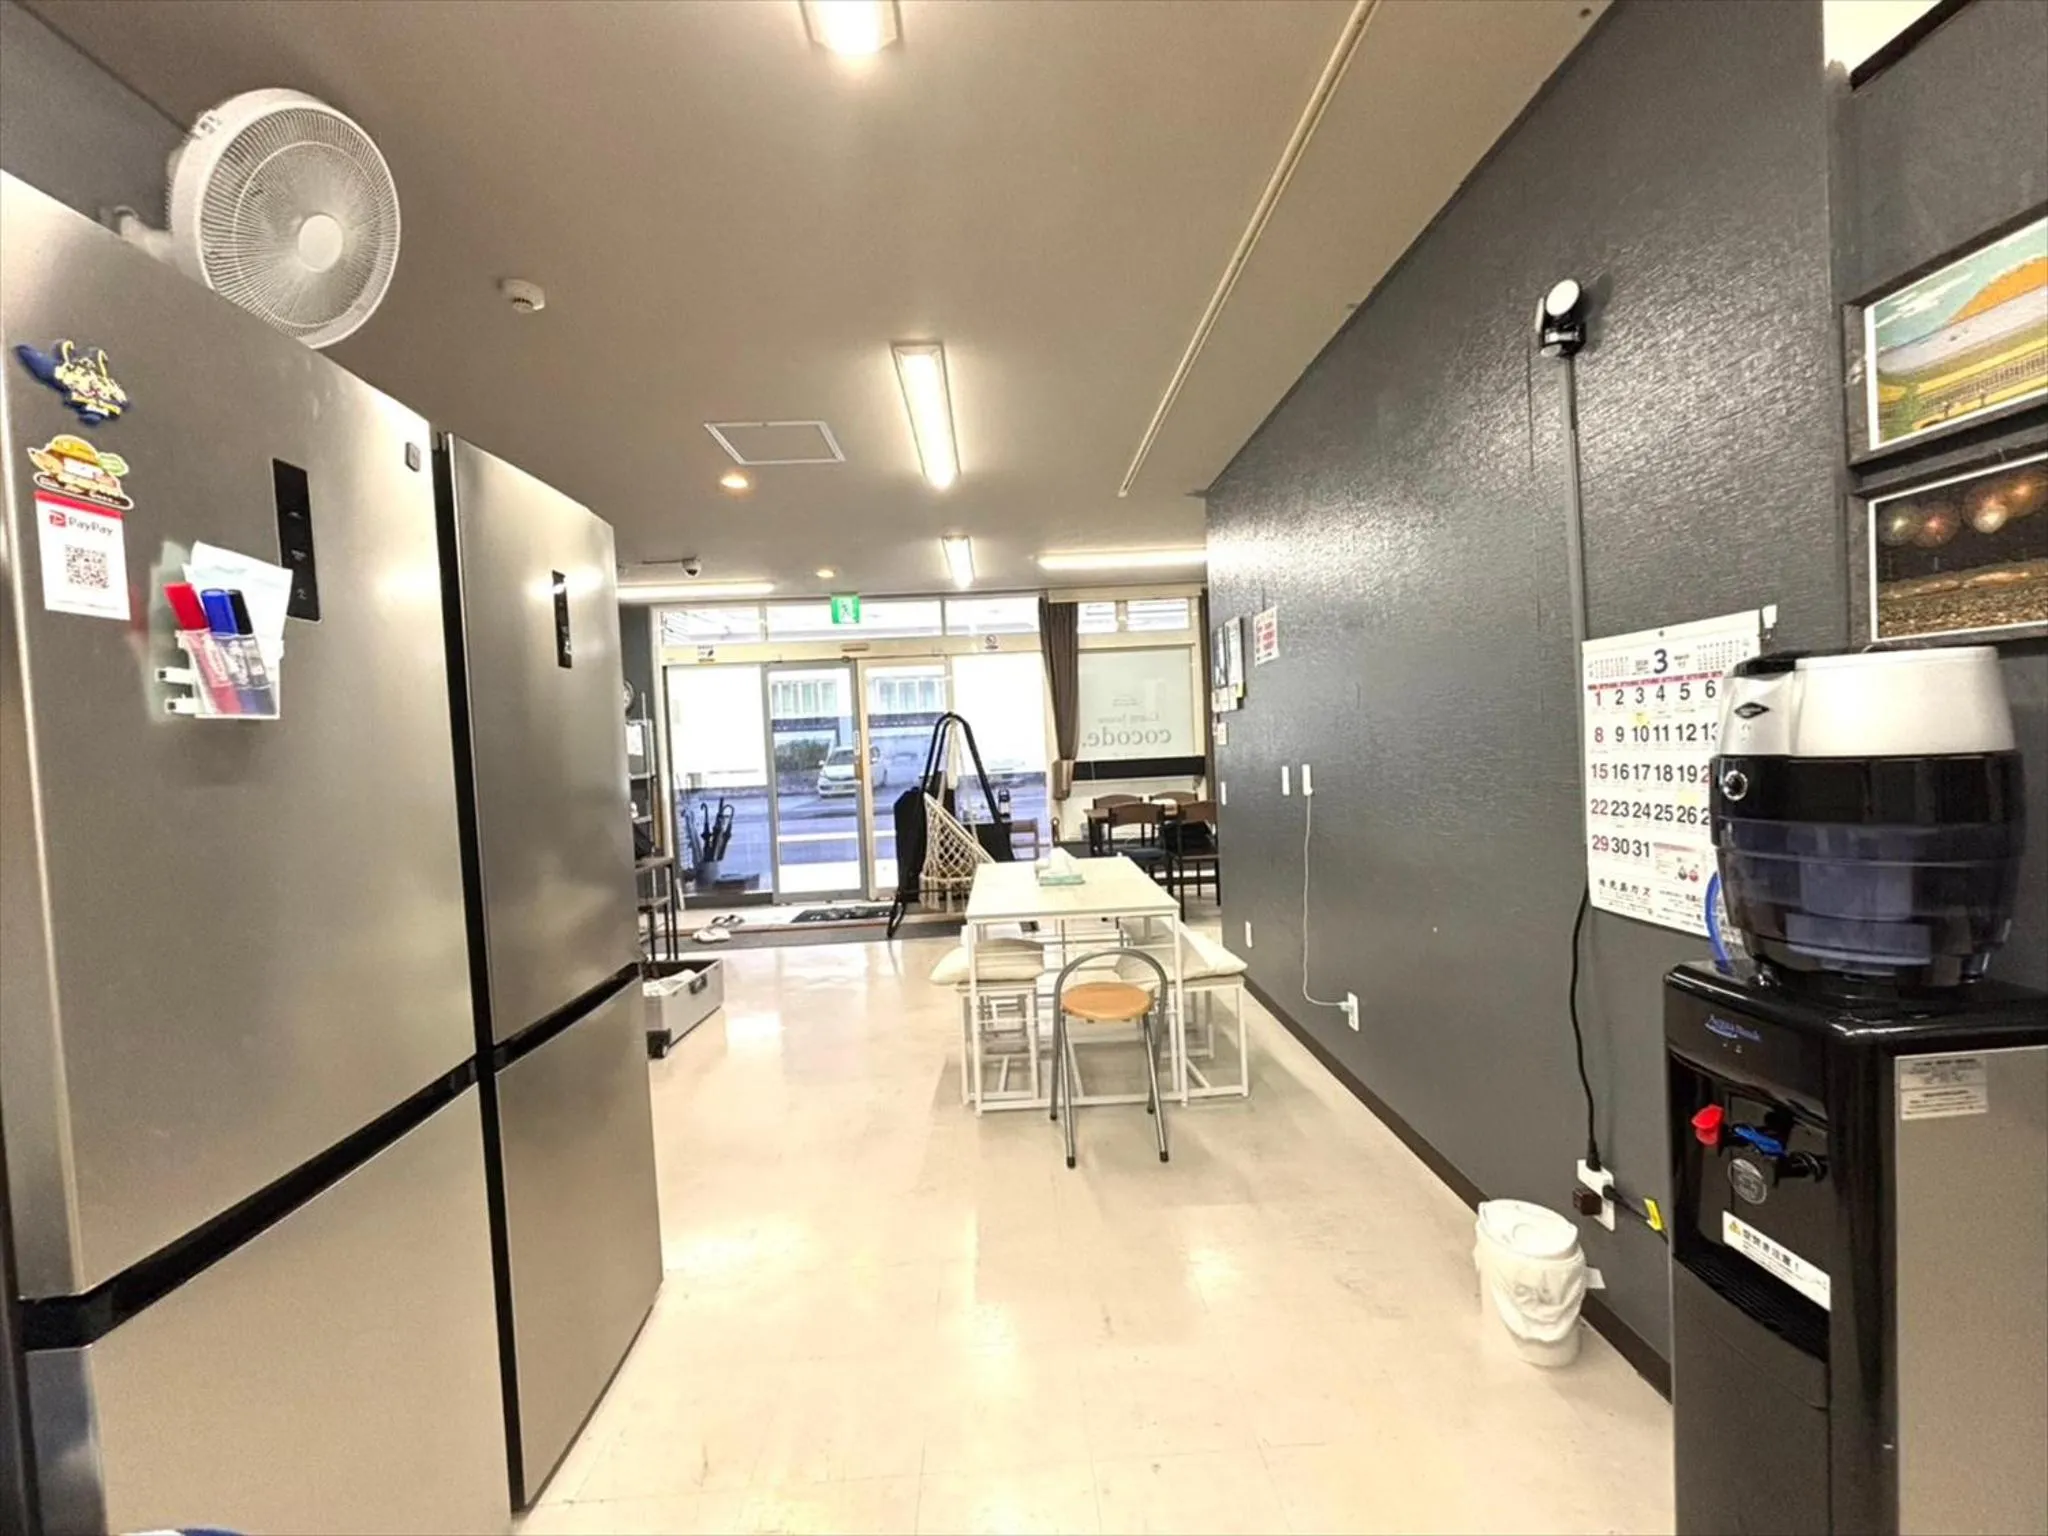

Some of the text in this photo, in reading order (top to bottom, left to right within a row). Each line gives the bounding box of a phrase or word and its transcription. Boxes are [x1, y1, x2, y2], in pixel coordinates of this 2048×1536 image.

[68, 516, 113, 537] PayPay
[1653, 648, 1669, 674] 3
[1594, 691, 1602, 706] 1
[1615, 689, 1625, 705] 2
[1635, 687, 1645, 704] 3
[1656, 685, 1666, 702] 4
[1679, 683, 1691, 701] 5
[1705, 680, 1716, 698] 6
[1594, 727, 1604, 743] 8
[1615, 726, 1625, 742] 9
[1632, 725, 1650, 742] 10
[1653, 724, 1670, 742] 11
[1675, 723, 1697, 742] 12
[1591, 763, 1609, 780] 15
[1611, 763, 1630, 780] 16
[1632, 763, 1651, 781] 17
[1654, 764, 1674, 782] 18
[1677, 764, 1698, 783] 19
[1590, 798, 1609, 816] 22
[1611, 800, 1630, 817] 23
[1632, 801, 1651, 819] 24
[1654, 803, 1674, 822] 25
[1676, 805, 1698, 824] 26
[1592, 834, 1609, 852] 29
[1611, 837, 1630, 855] 30
[1632, 839, 1650, 858] 31
